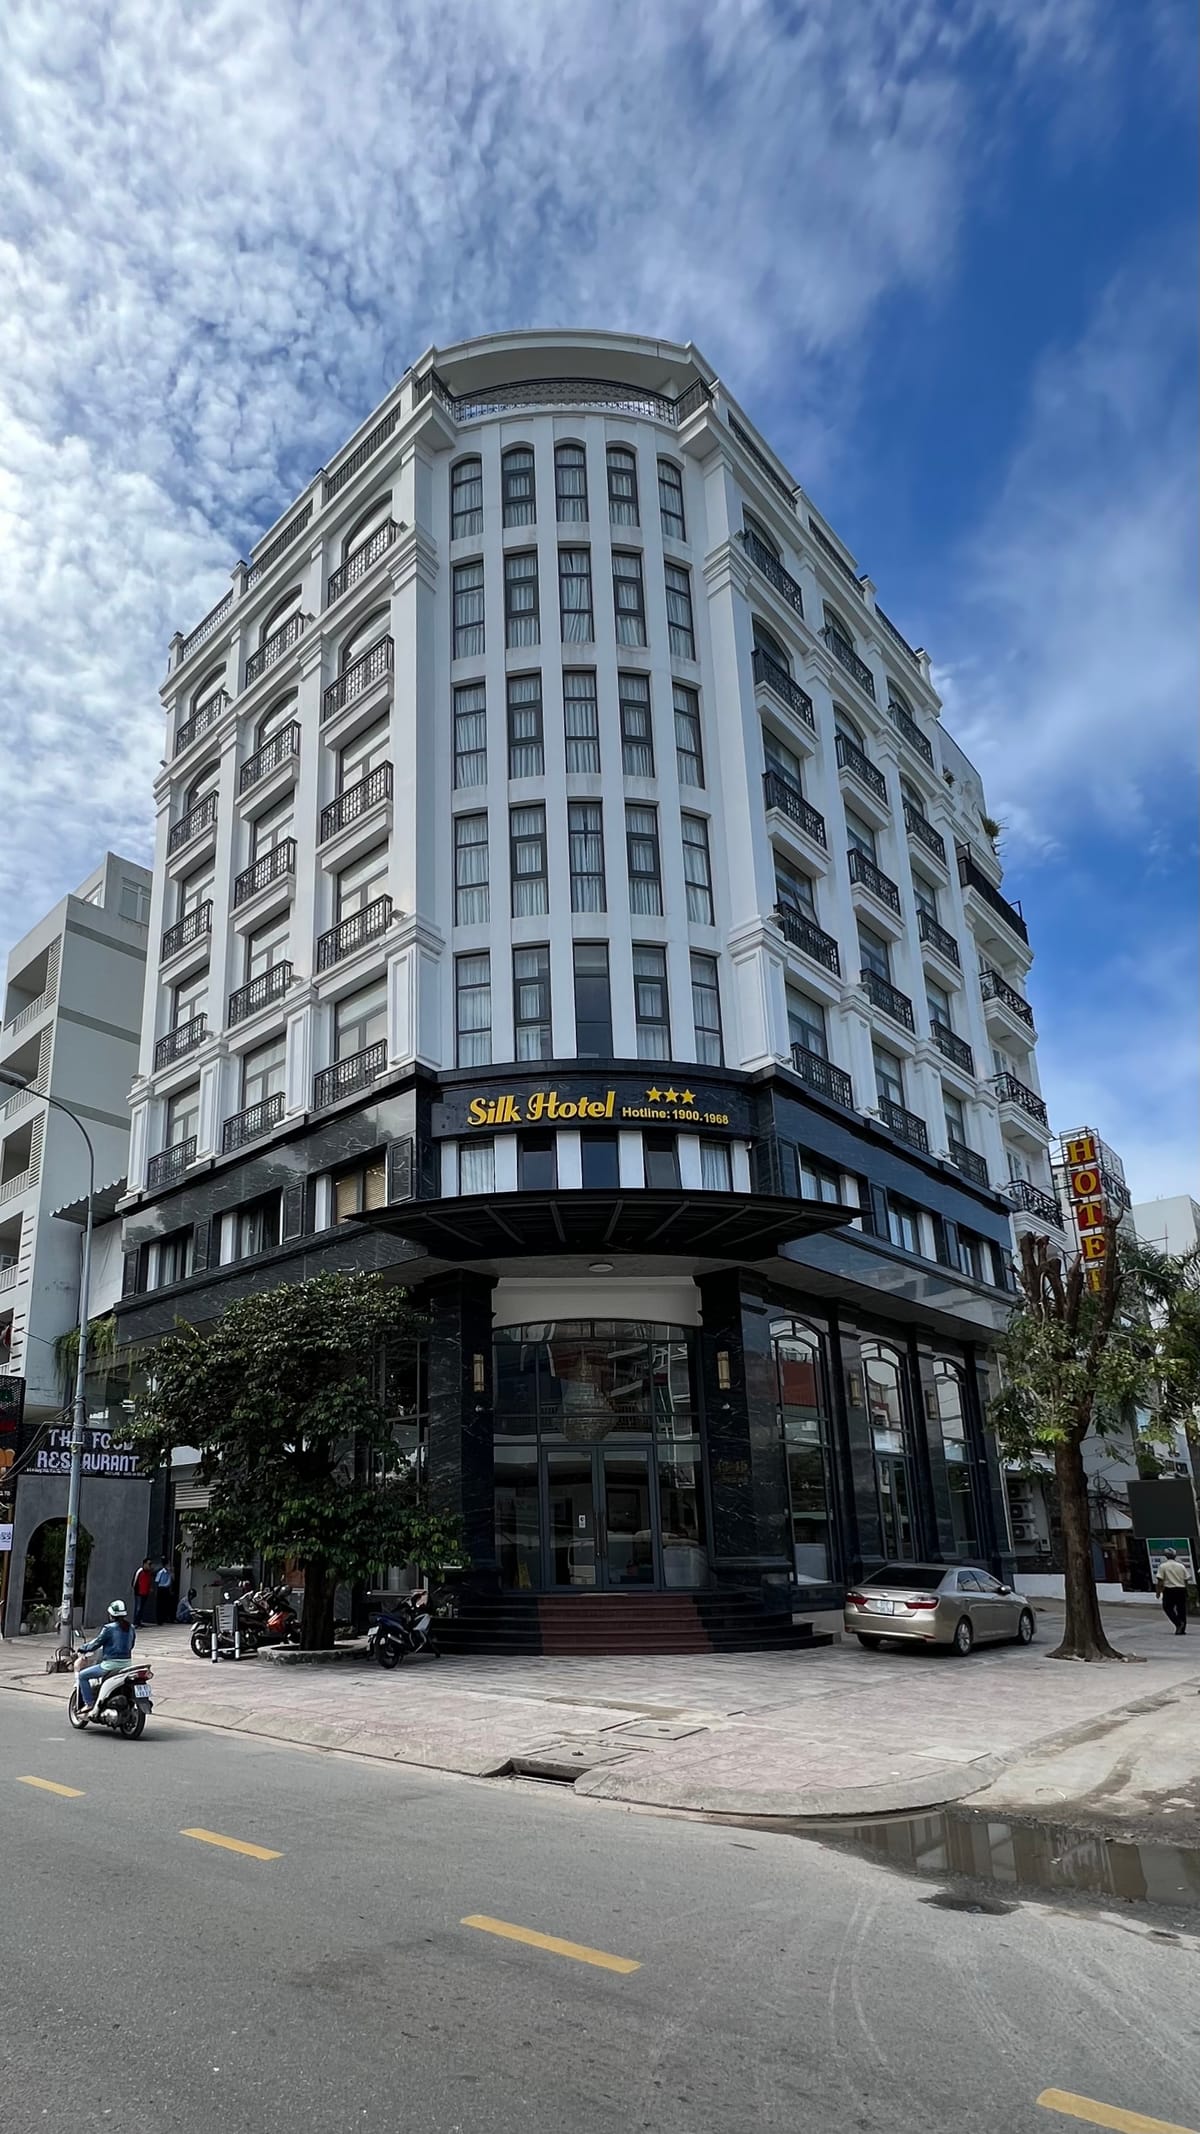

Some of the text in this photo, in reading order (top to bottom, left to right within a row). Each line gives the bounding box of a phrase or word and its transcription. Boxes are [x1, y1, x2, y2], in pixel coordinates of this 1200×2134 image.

[467, 1091, 616, 1125] Silk Hotel
[622, 1107, 729, 1125] Hotline: 1900.1968
[37, 1450, 140, 1473] RESAURANT
